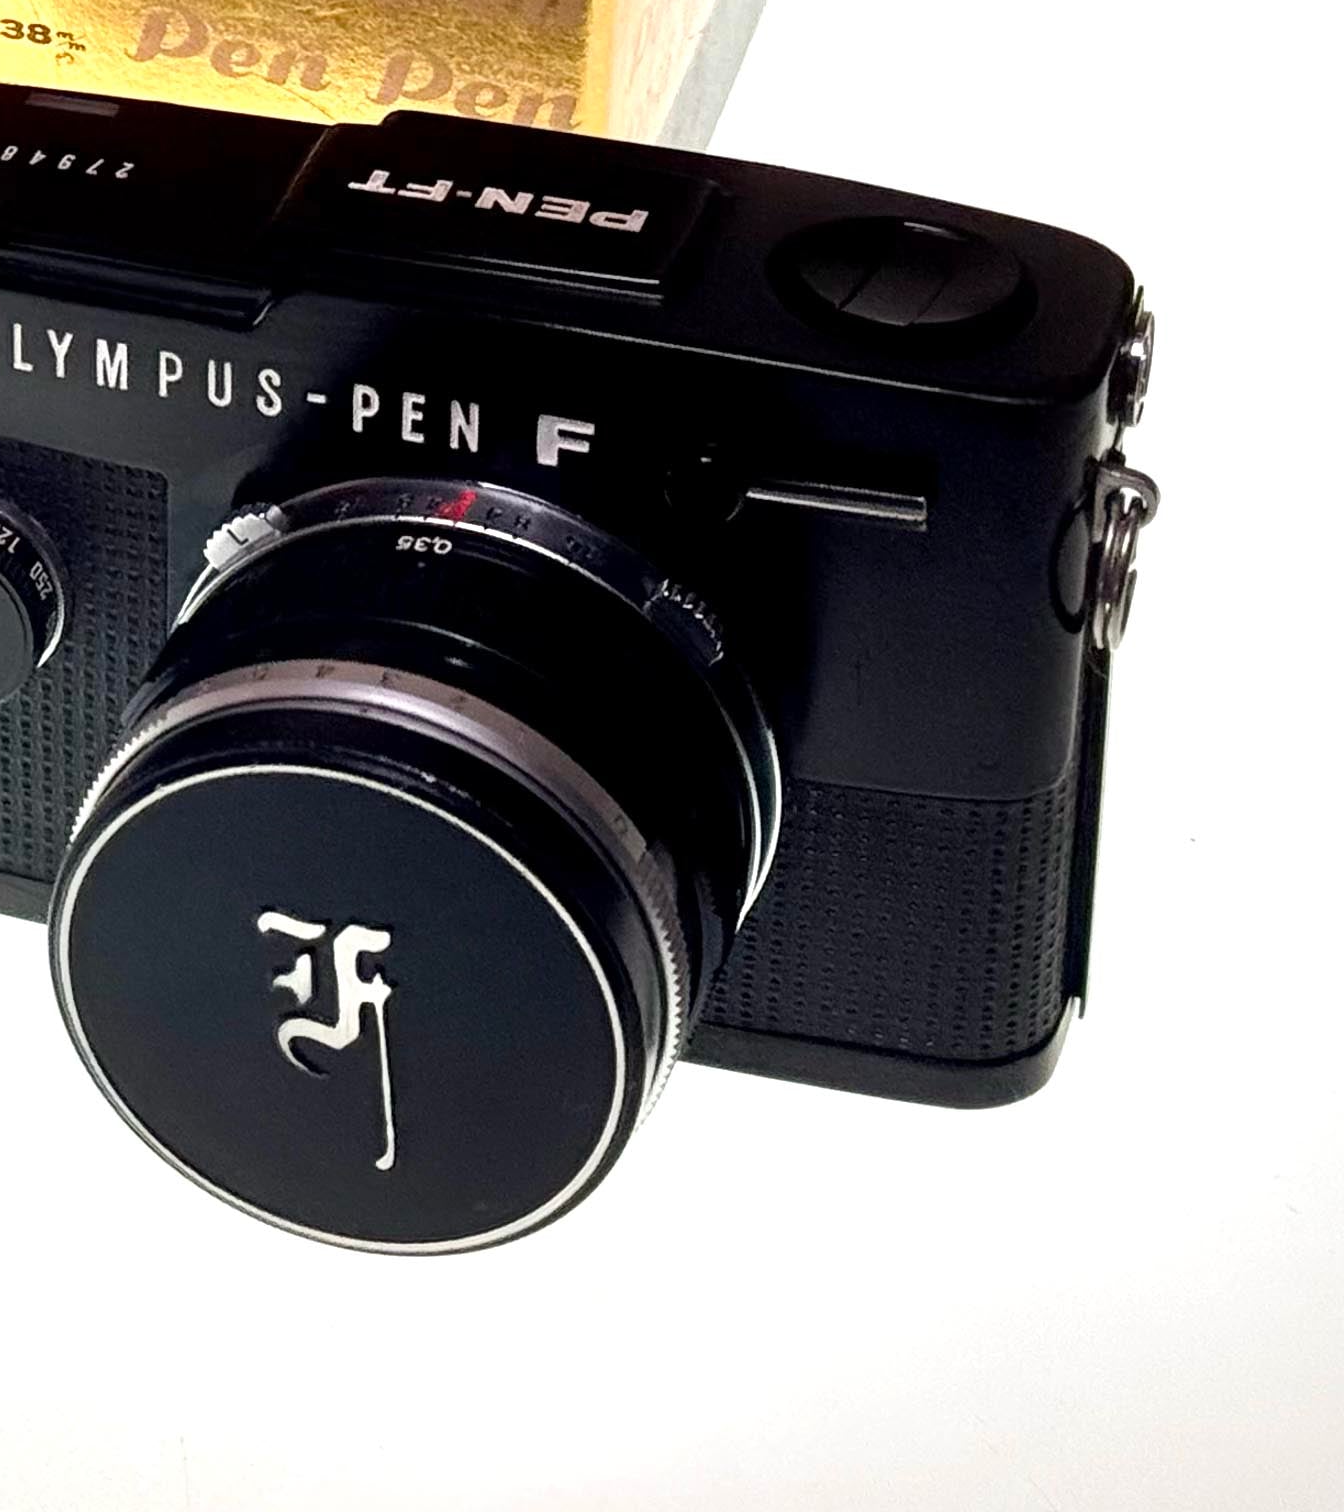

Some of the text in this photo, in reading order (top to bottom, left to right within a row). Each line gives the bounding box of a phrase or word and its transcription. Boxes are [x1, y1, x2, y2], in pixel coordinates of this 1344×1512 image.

[124, 6, 331, 91] Pen
[366, 48, 582, 131] Pen
[348, 169, 651, 233] PEN-FT
[536, 414, 596, 468] F
[29, 560, 54, 601] 250
